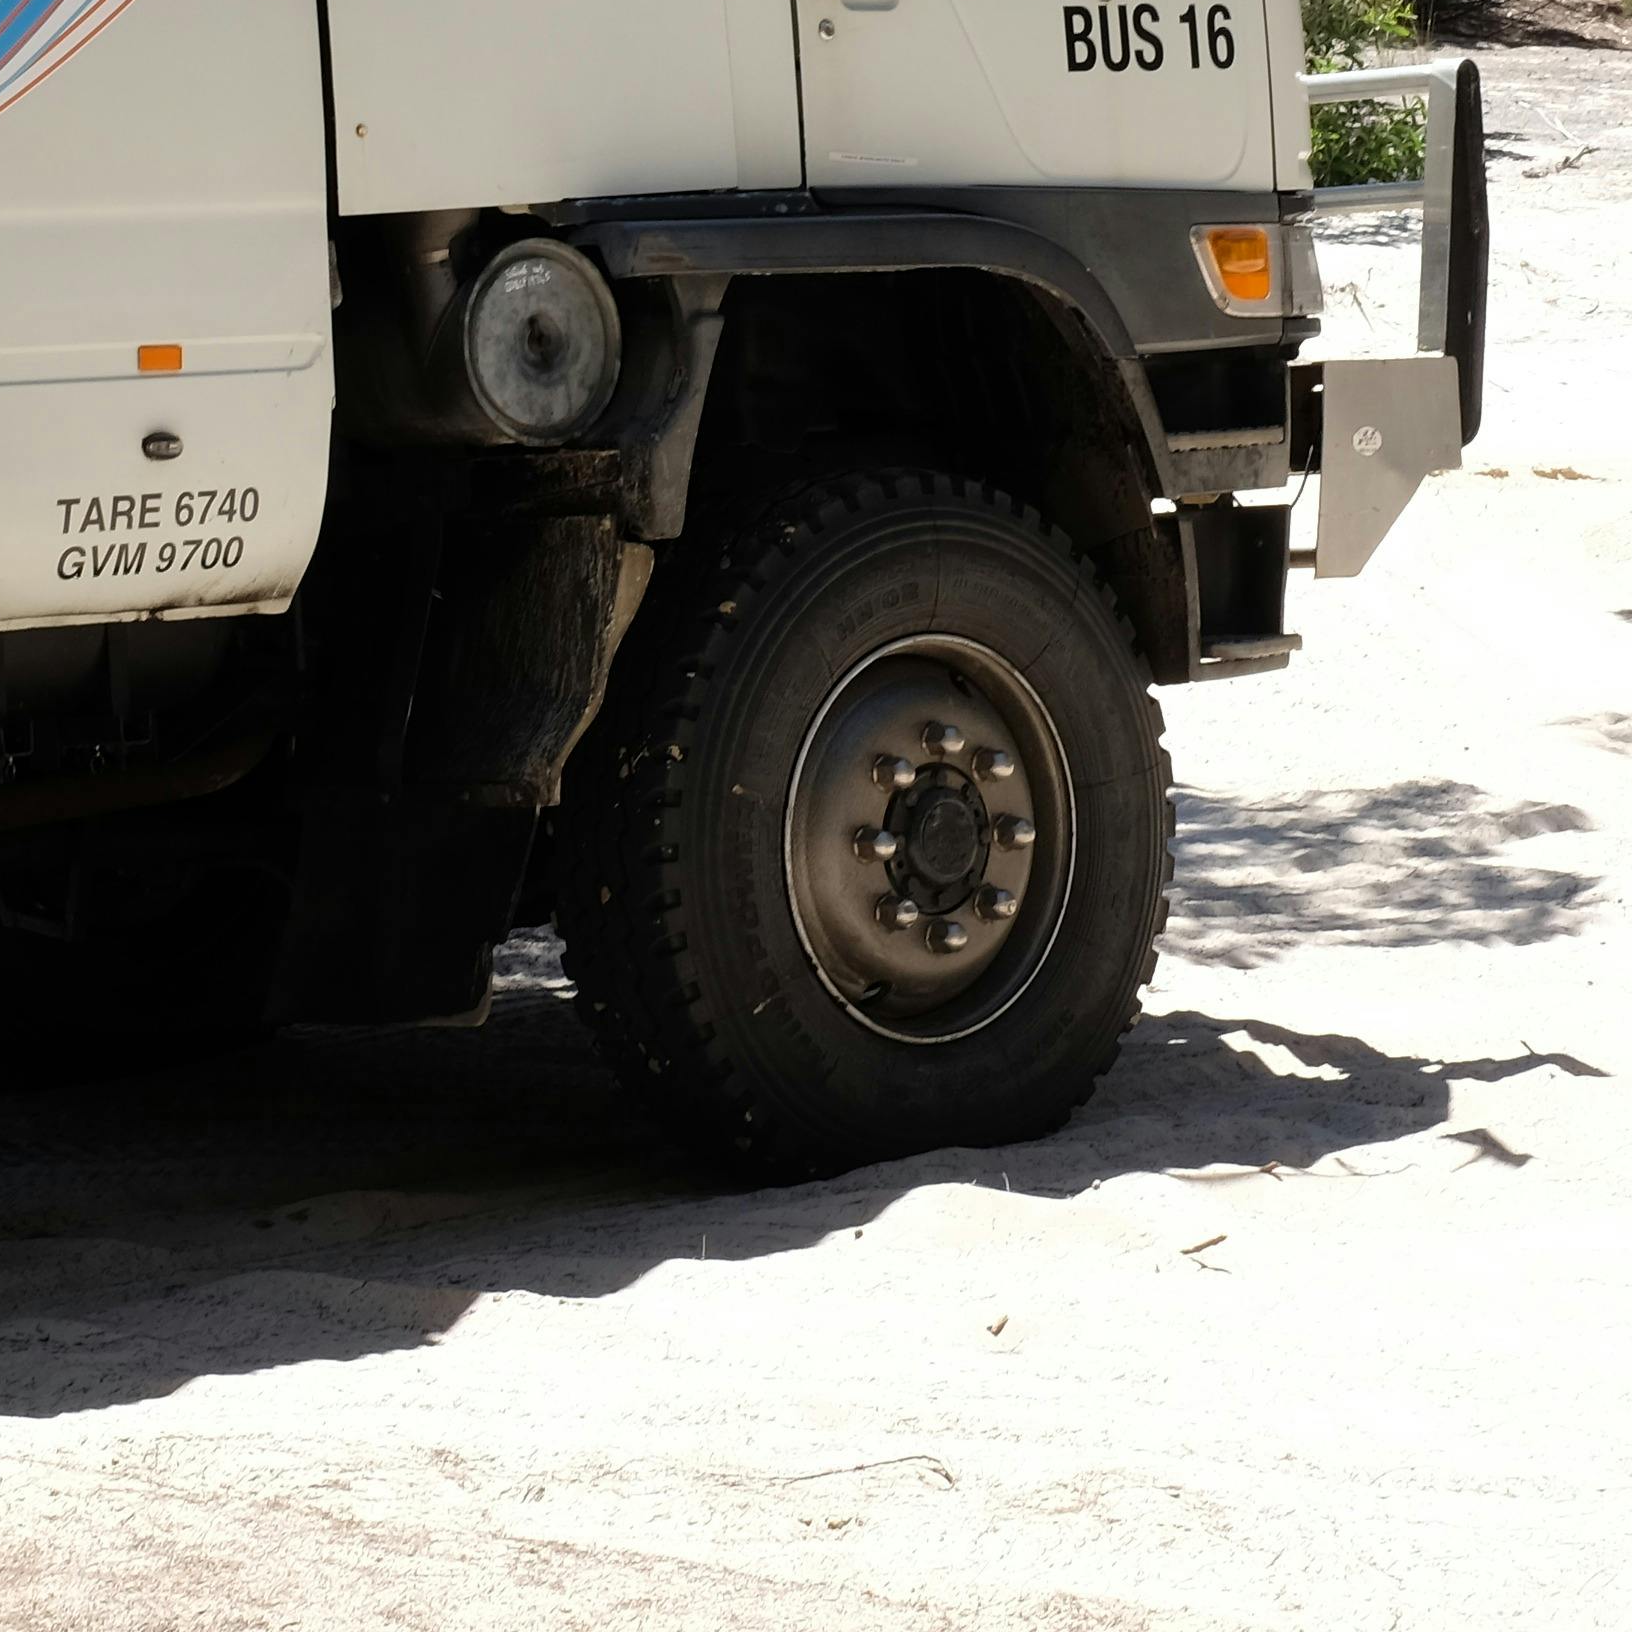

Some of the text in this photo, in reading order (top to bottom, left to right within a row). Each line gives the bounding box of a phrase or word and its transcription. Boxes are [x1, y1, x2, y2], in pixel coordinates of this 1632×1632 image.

[1063, 3, 1235, 72] BUS 16
[57, 487, 260, 534] TARE 6740
[57, 536, 244, 580] GVM 9700
